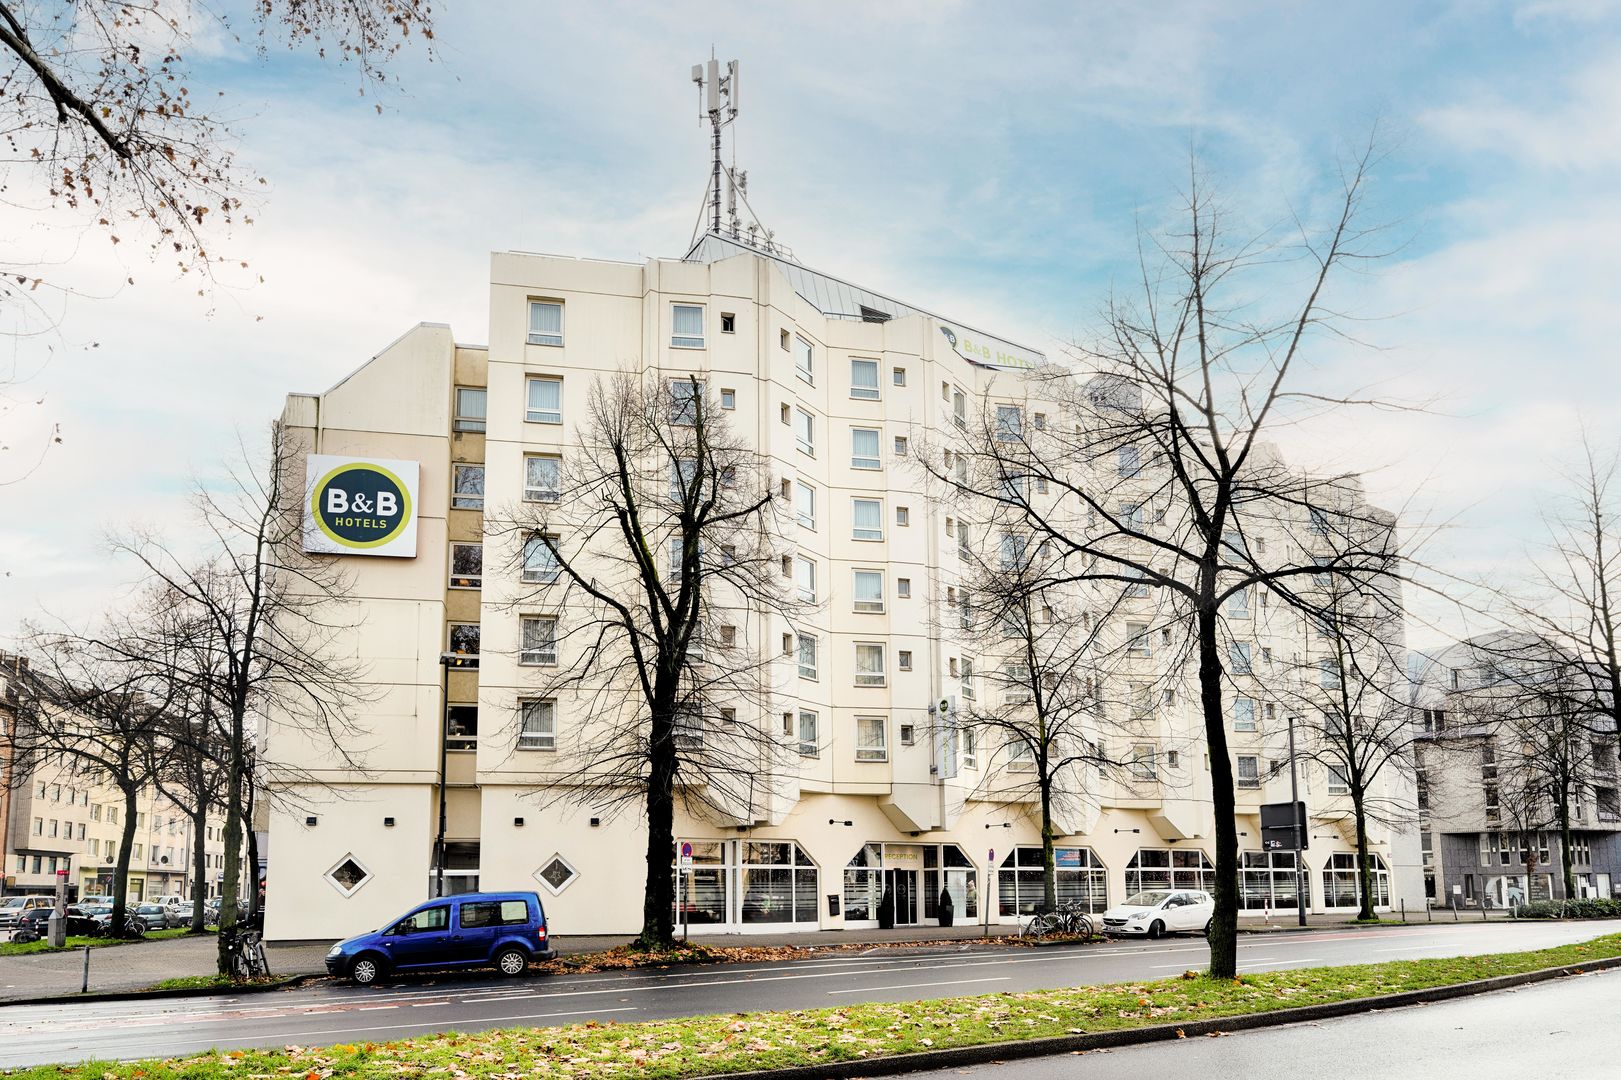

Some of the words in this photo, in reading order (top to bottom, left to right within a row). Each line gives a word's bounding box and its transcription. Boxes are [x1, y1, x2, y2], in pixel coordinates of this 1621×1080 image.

[964, 339, 991, 358] B&B
[327, 488, 398, 516] B&B
[335, 517, 387, 528] HOTELS
